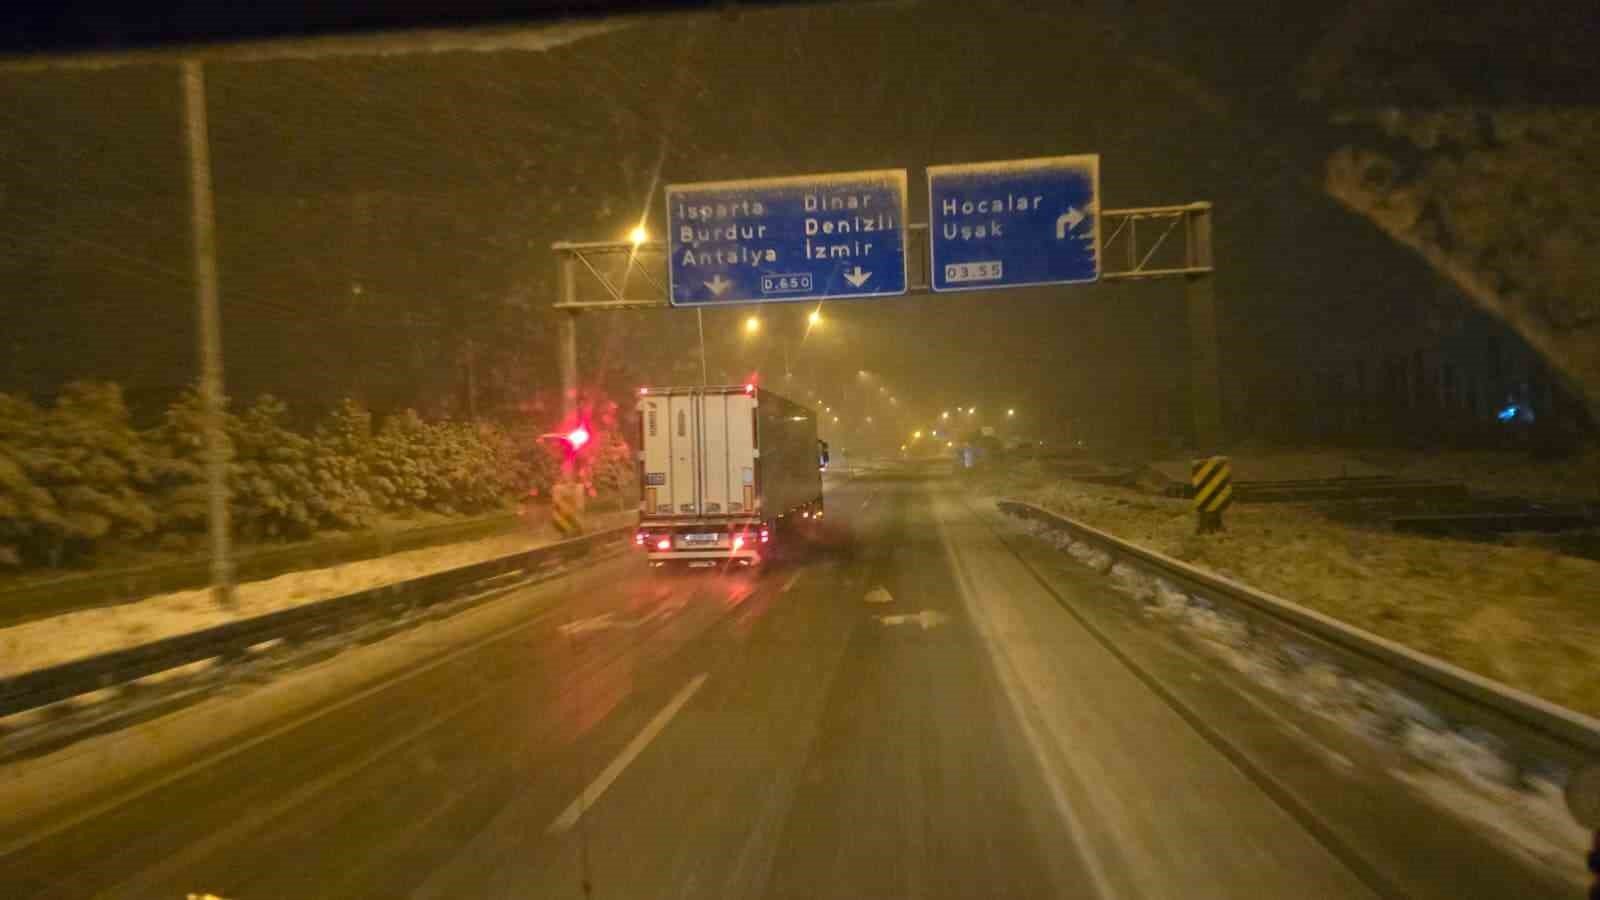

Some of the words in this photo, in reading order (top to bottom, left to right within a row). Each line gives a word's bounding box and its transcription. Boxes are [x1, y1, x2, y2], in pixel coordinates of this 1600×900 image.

[804, 192, 871, 212] Dinar
[943, 193, 1043, 215] Hocalar
[680, 224, 767, 243] Burdur
[805, 213, 893, 236] Denizli
[943, 220, 1003, 240] Uşak
[682, 247, 777, 267] Antalya
[764, 277, 810, 290] D.650
